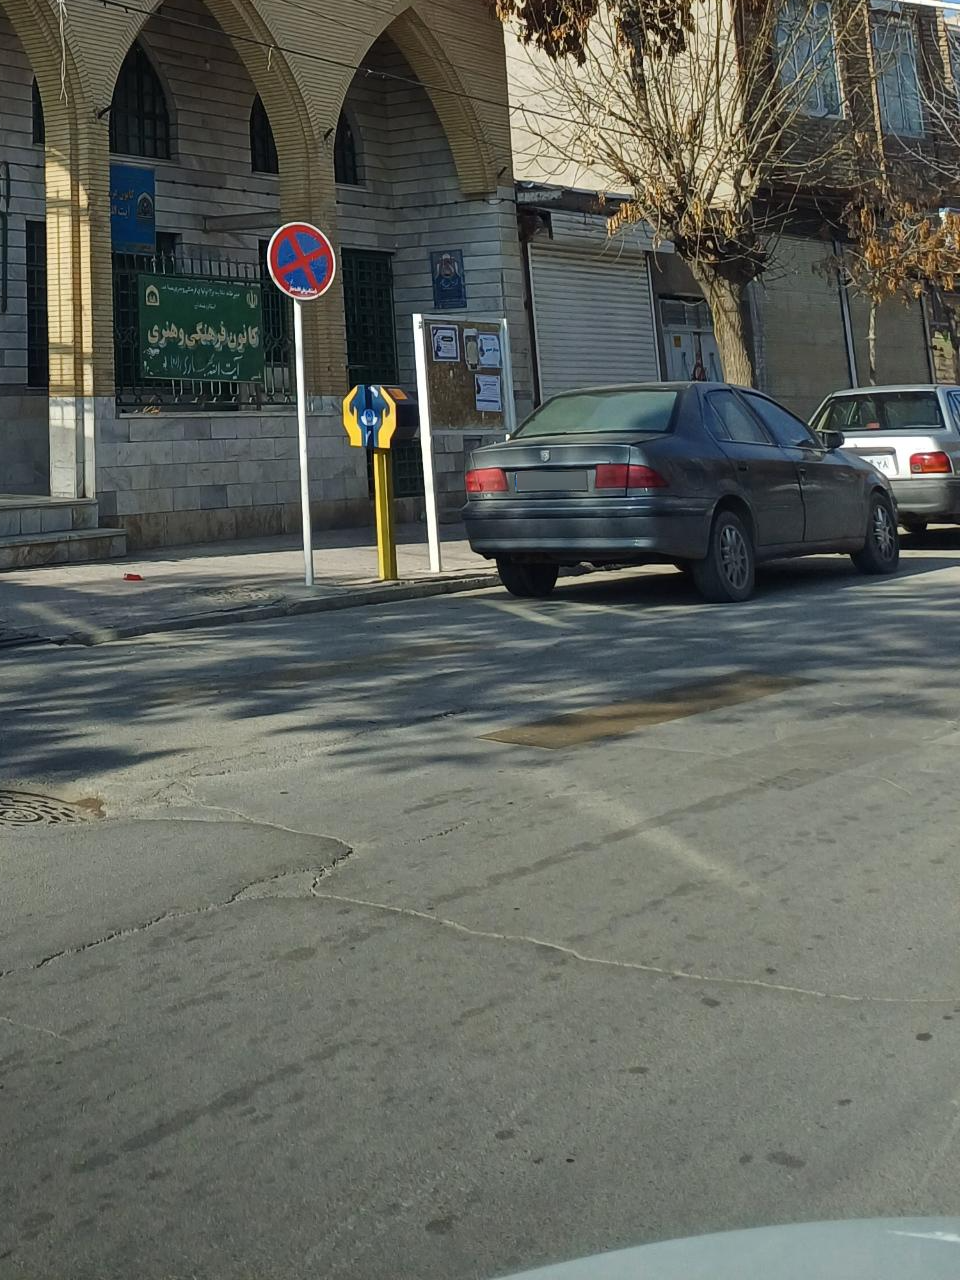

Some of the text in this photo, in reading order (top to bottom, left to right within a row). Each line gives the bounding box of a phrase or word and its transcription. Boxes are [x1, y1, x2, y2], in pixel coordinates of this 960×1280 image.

[147, 320, 260, 353] کانون فرهنگی و هنری
